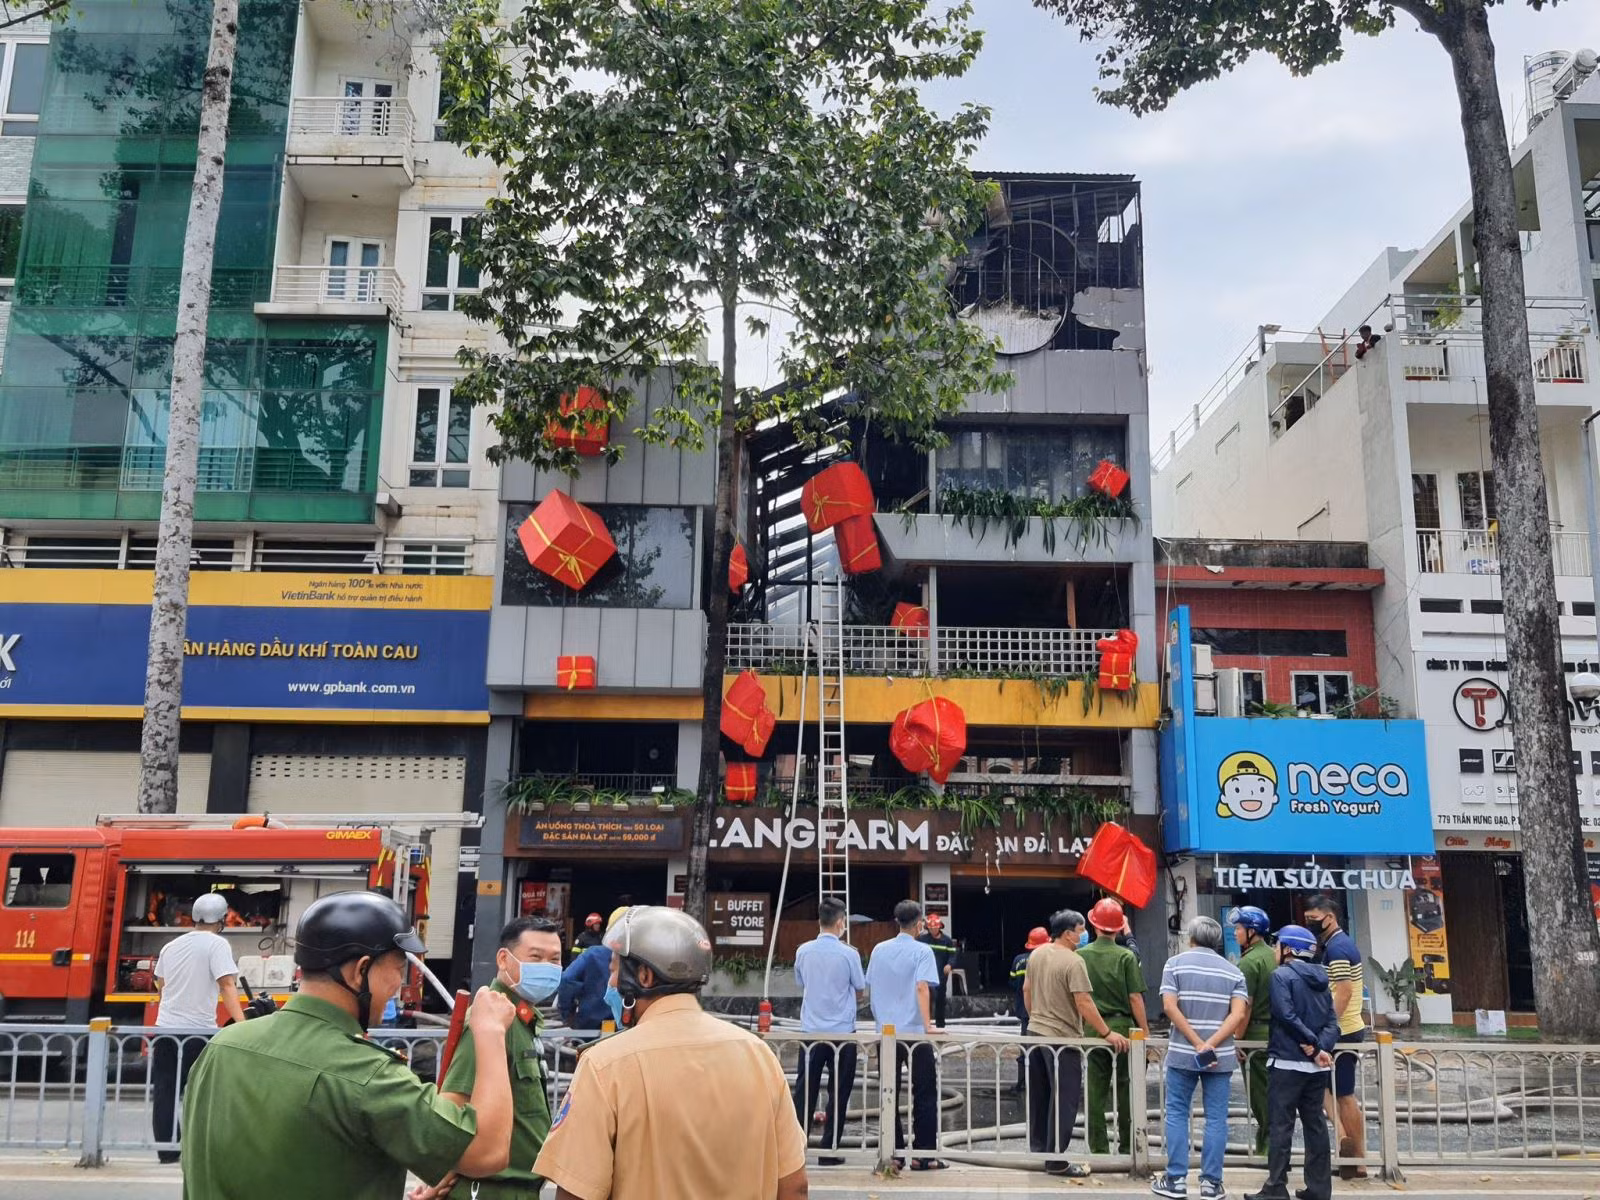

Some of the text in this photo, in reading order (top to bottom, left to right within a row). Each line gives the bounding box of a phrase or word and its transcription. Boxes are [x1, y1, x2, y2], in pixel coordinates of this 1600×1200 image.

[348, 578, 375, 589] 100%
[281, 590, 335, 601] VietinBank
[207, 638, 256, 657] HÀNG
[260, 636, 294, 658] DẦU
[298, 640, 329, 658] KHÍ
[332, 641, 378, 659] TOÀN
[287, 681, 416, 695] www.gpbank.com.vn
[1287, 762, 1410, 797] neca
[1290, 799, 1381, 818] Fresh Yogurt
[326, 831, 371, 840] GIMAEX
[709, 816, 929, 850] 'ANGFARM
[1214, 861, 1417, 893] TIỆM SỮA CHUA
[727, 900, 764, 911] BUFFET
[730, 916, 764, 928] STORE
[15, 929, 36, 949] 114
